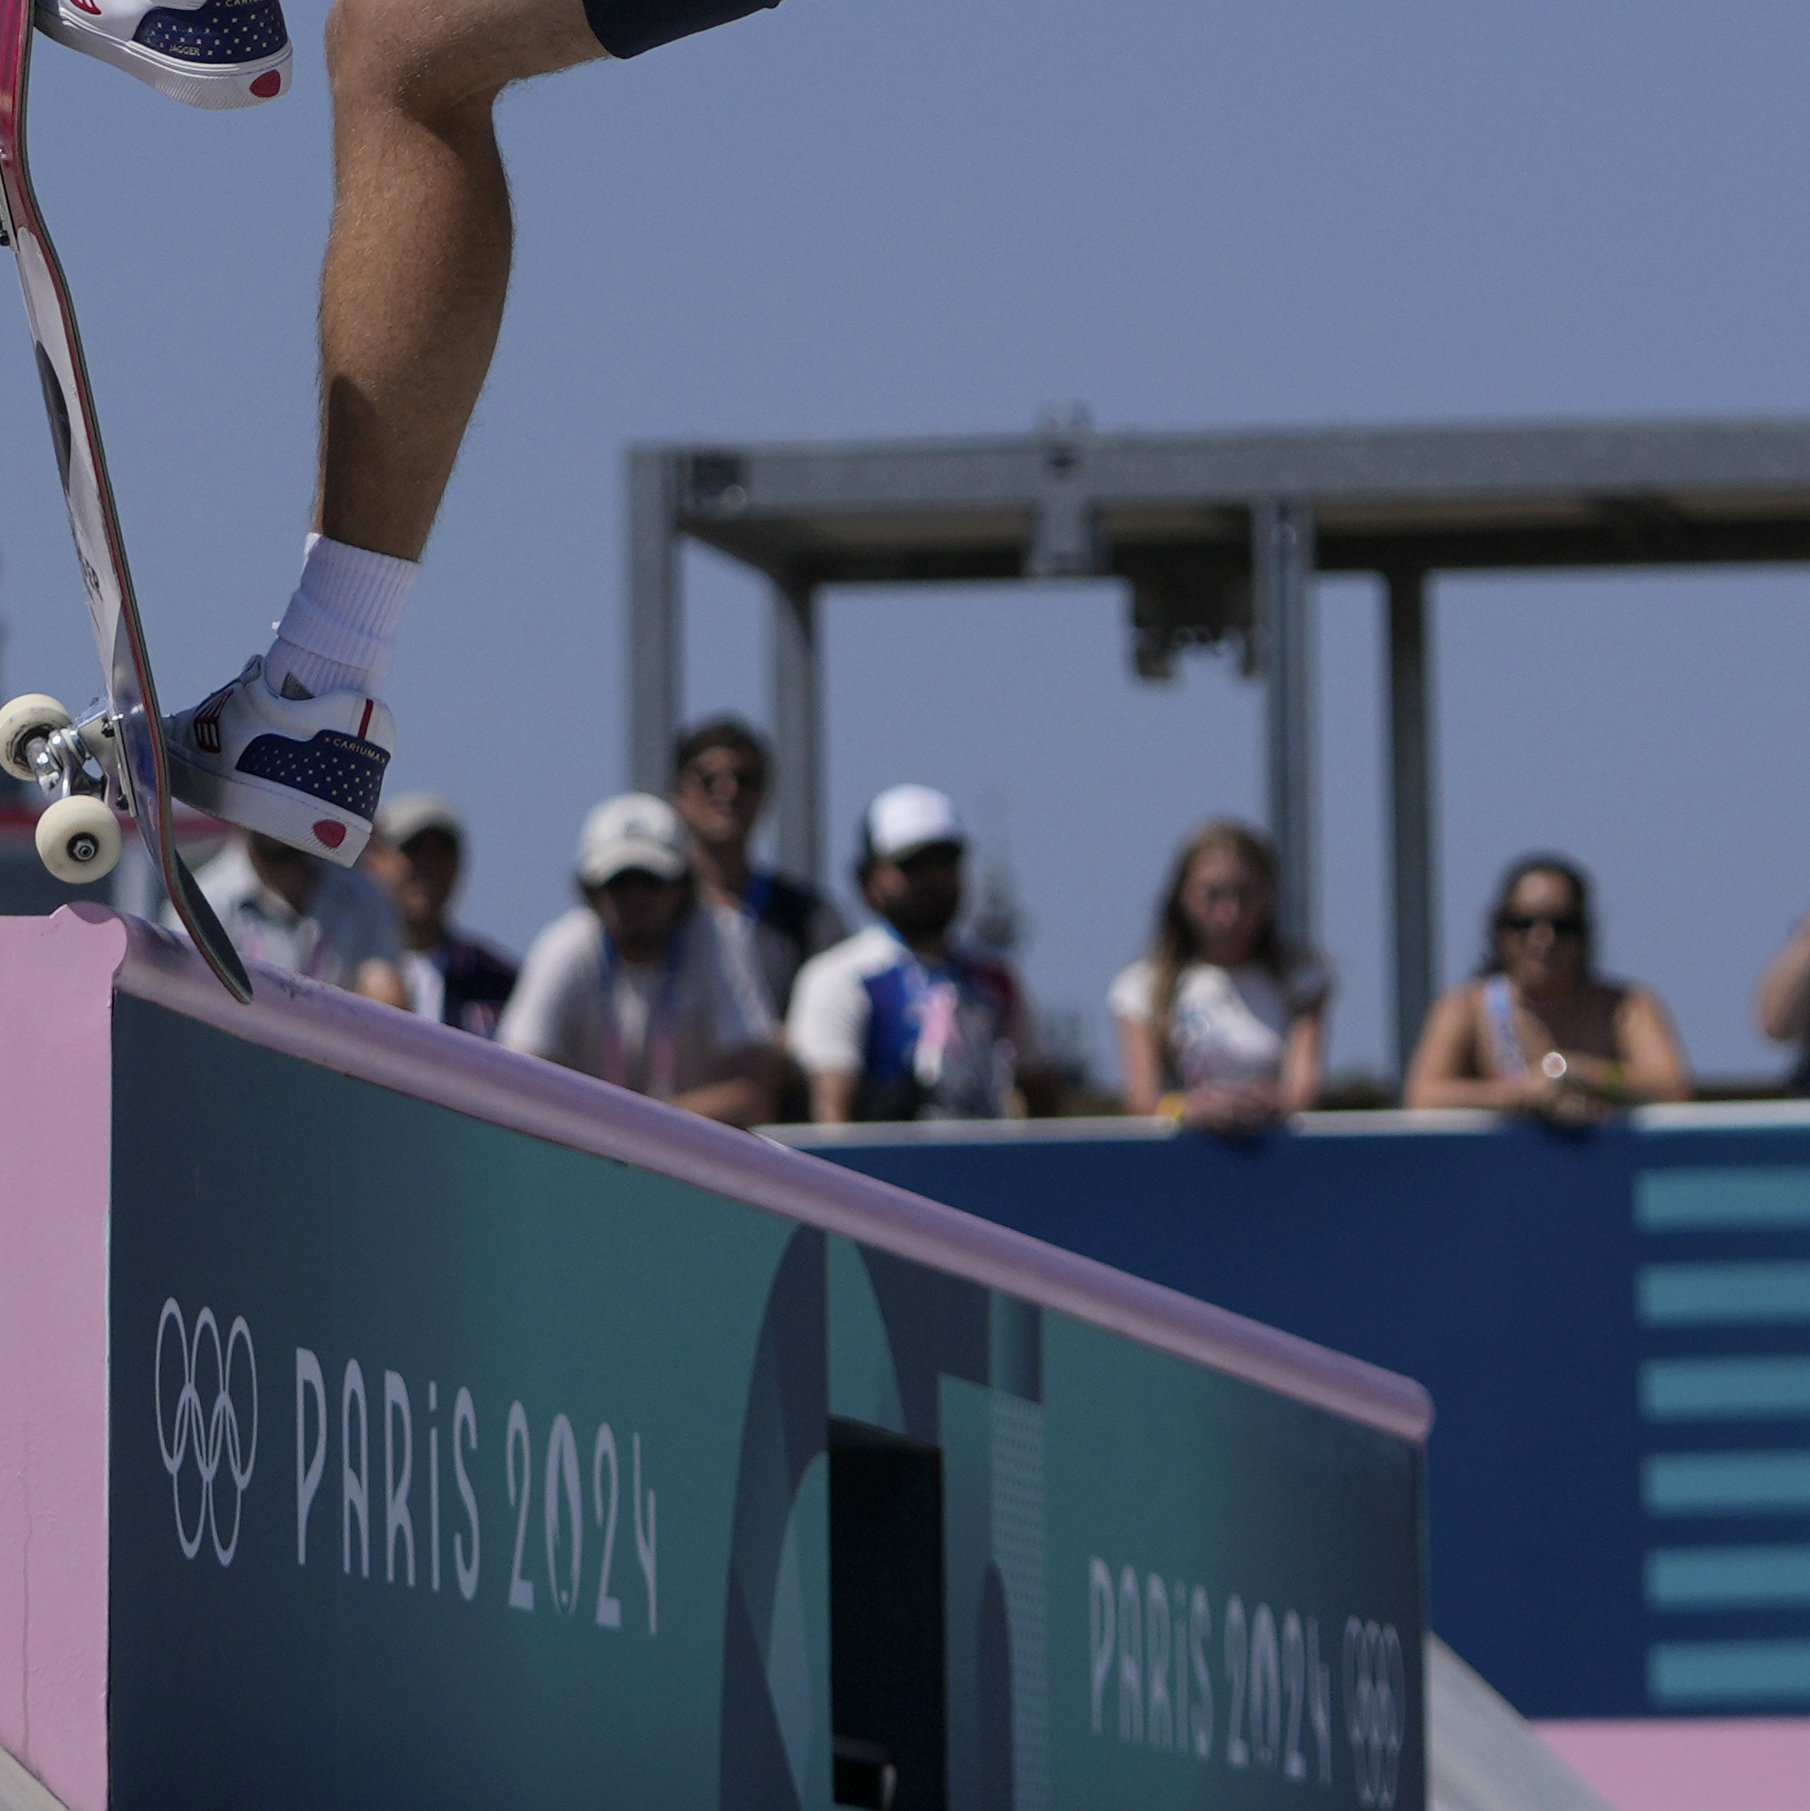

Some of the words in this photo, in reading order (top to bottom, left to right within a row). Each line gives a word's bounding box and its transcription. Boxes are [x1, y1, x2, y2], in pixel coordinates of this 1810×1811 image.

[333, 739, 380, 761] CARIUMA
[507, 1400, 657, 1635] 2024
[1225, 1595, 1330, 1785] 2024
